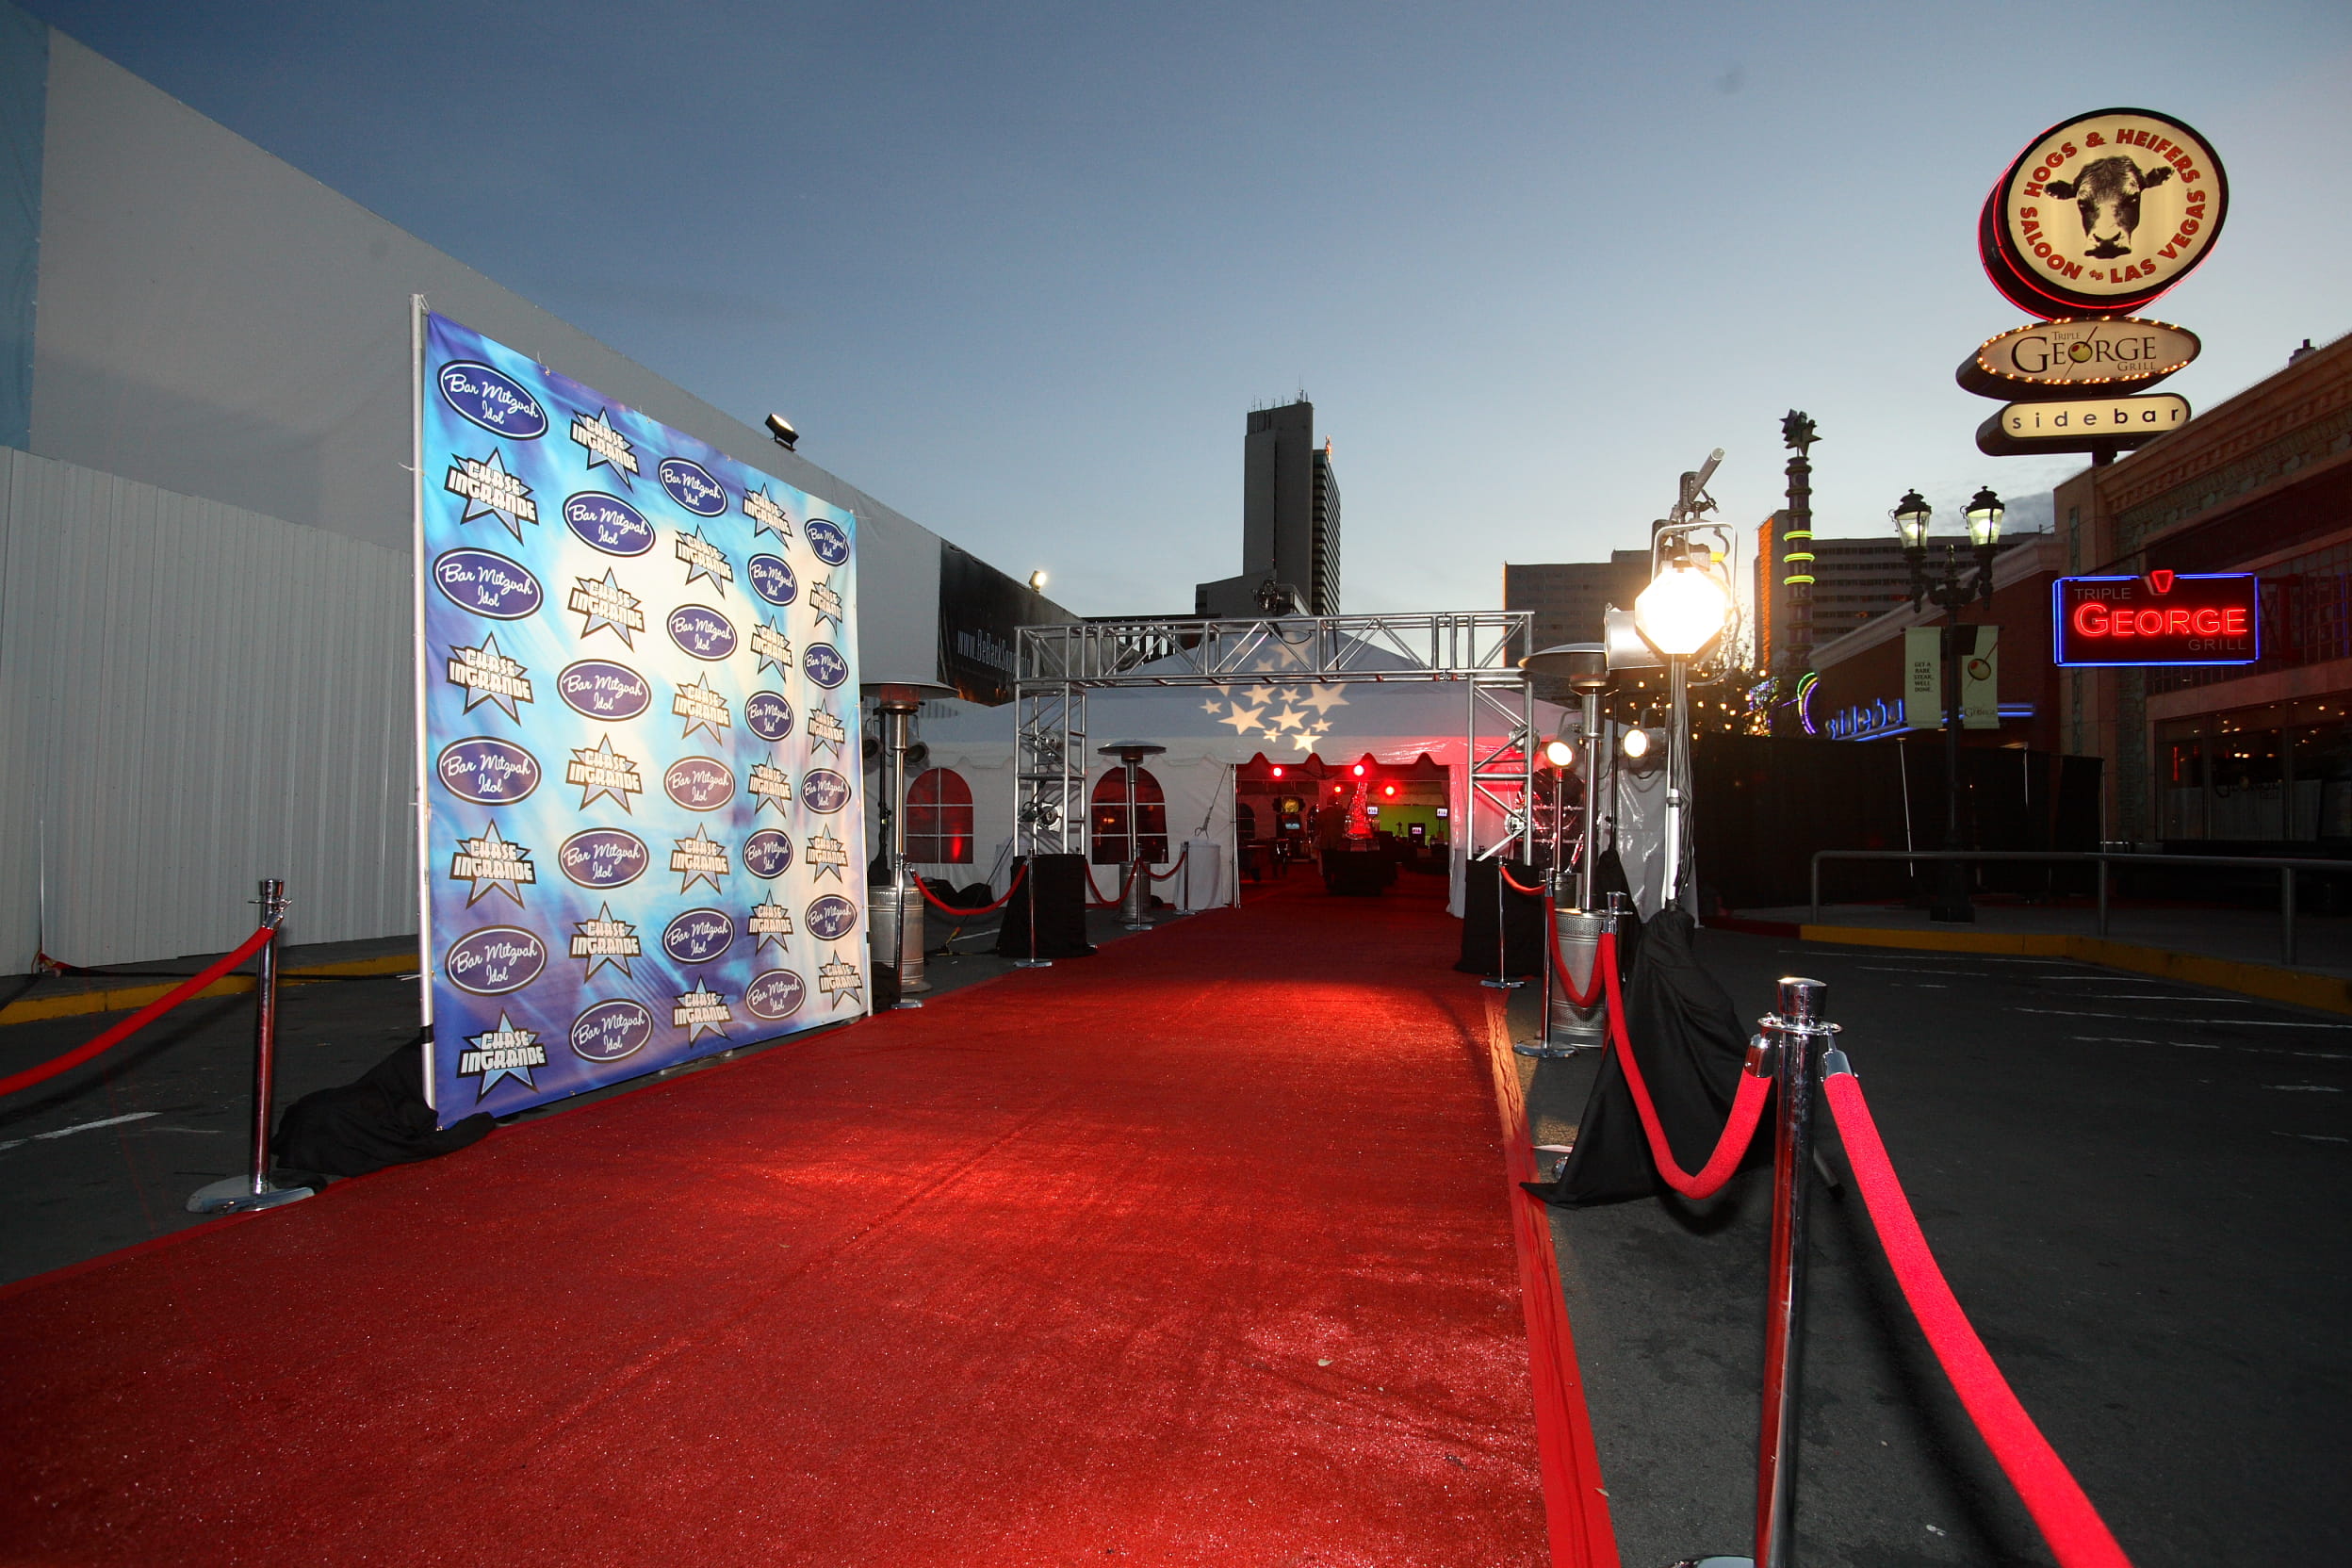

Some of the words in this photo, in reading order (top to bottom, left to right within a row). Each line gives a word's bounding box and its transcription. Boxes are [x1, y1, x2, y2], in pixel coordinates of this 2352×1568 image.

[2023, 141, 2078, 198] HOGS
[2085, 132, 2107, 148] &
[2115, 128, 2200, 184] HEIFERS
[2019, 206, 2083, 281] SALOON
[2110, 258, 2157, 284] LAS
[2156, 189, 2206, 260] VEGAS
[2051, 331, 2081, 341] TRIPLE
[2011, 335, 2157, 373] GEORGE
[2116, 361, 2156, 371] GRILL
[445, 373, 479, 395] Bar
[482, 381, 539, 417] Mitzvah
[482, 400, 505, 424] Idol
[2012, 408, 2179, 430] sidebar
[586, 416, 625, 450] CHASE
[572, 421, 639, 473] INGRANDE
[467, 459, 521, 496] CHASE
[662, 468, 681, 484] Bar
[681, 473, 722, 499] Mitzvah
[447, 469, 536, 521] INGRANDE
[683, 487, 700, 506] Idol
[568, 504, 597, 521] Bar
[599, 507, 648, 535] Mitzvah
[598, 525, 619, 545] Idol
[686, 534, 719, 562] CHASE
[440, 564, 475, 583] Bar
[478, 566, 533, 595] Mitzvah
[750, 564, 767, 580] Bar
[478, 585, 499, 607] Idol
[589, 580, 631, 610] CHASE
[766, 580, 778, 596] Idol
[2073, 587, 2132, 600] TRIPLE
[570, 589, 644, 631] INGRANDE
[2073, 602, 2247, 637] GEORGE
[671, 616, 694, 633] Bar
[694, 617, 732, 641] Mitzvah
[694, 633, 710, 651] Idol
[2187, 639, 2247, 651] GRILL
[466, 648, 516, 678] CHASE
[449, 661, 532, 700] INGRANDE
[564, 675, 592, 693] Bar
[595, 675, 643, 699] Mitzvah
[593, 693, 614, 710] Idol
[689, 684, 720, 708] CHASE
[747, 703, 764, 719] Bar
[1824, 698, 1904, 741] sideba
[764, 717, 776, 732] Idol
[443, 756, 477, 777] Bar
[480, 754, 531, 779] Mitzvah
[585, 751, 627, 774] CHASE
[478, 774, 503, 793] Idol
[568, 763, 641, 792] INGRANDE
[669, 772, 691, 790] Bar
[692, 770, 729, 792] Mitzvah
[692, 786, 708, 803] Idol
[470, 839, 517, 860] CHASE
[563, 847, 591, 867] Bar
[593, 843, 641, 865] Mitzvah
[685, 839, 717, 856] CHASE
[745, 846, 762, 861] Bar
[453, 856, 533, 881] INGRANDE
[592, 861, 612, 880] Idol
[763, 857, 776, 871] Idol
[587, 921, 627, 938] CHASE
[667, 927, 691, 947] Bar
[691, 920, 728, 939] Mitzvah
[451, 951, 483, 973] Bar
[484, 939, 538, 966] Mitzvah
[572, 937, 640, 956] INGRANDE
[691, 939, 708, 956] Idol
[485, 964, 509, 986] Idol
[684, 992, 717, 1007] CHASE
[749, 989, 767, 1005] Bar
[770, 996, 785, 1013] Idol
[575, 1023, 600, 1045] Bar
[601, 1009, 645, 1035] Mitzvah
[481, 1030, 530, 1050] CHASE
[603, 1035, 623, 1054] Idol
[460, 1046, 546, 1074] INGRANDE
